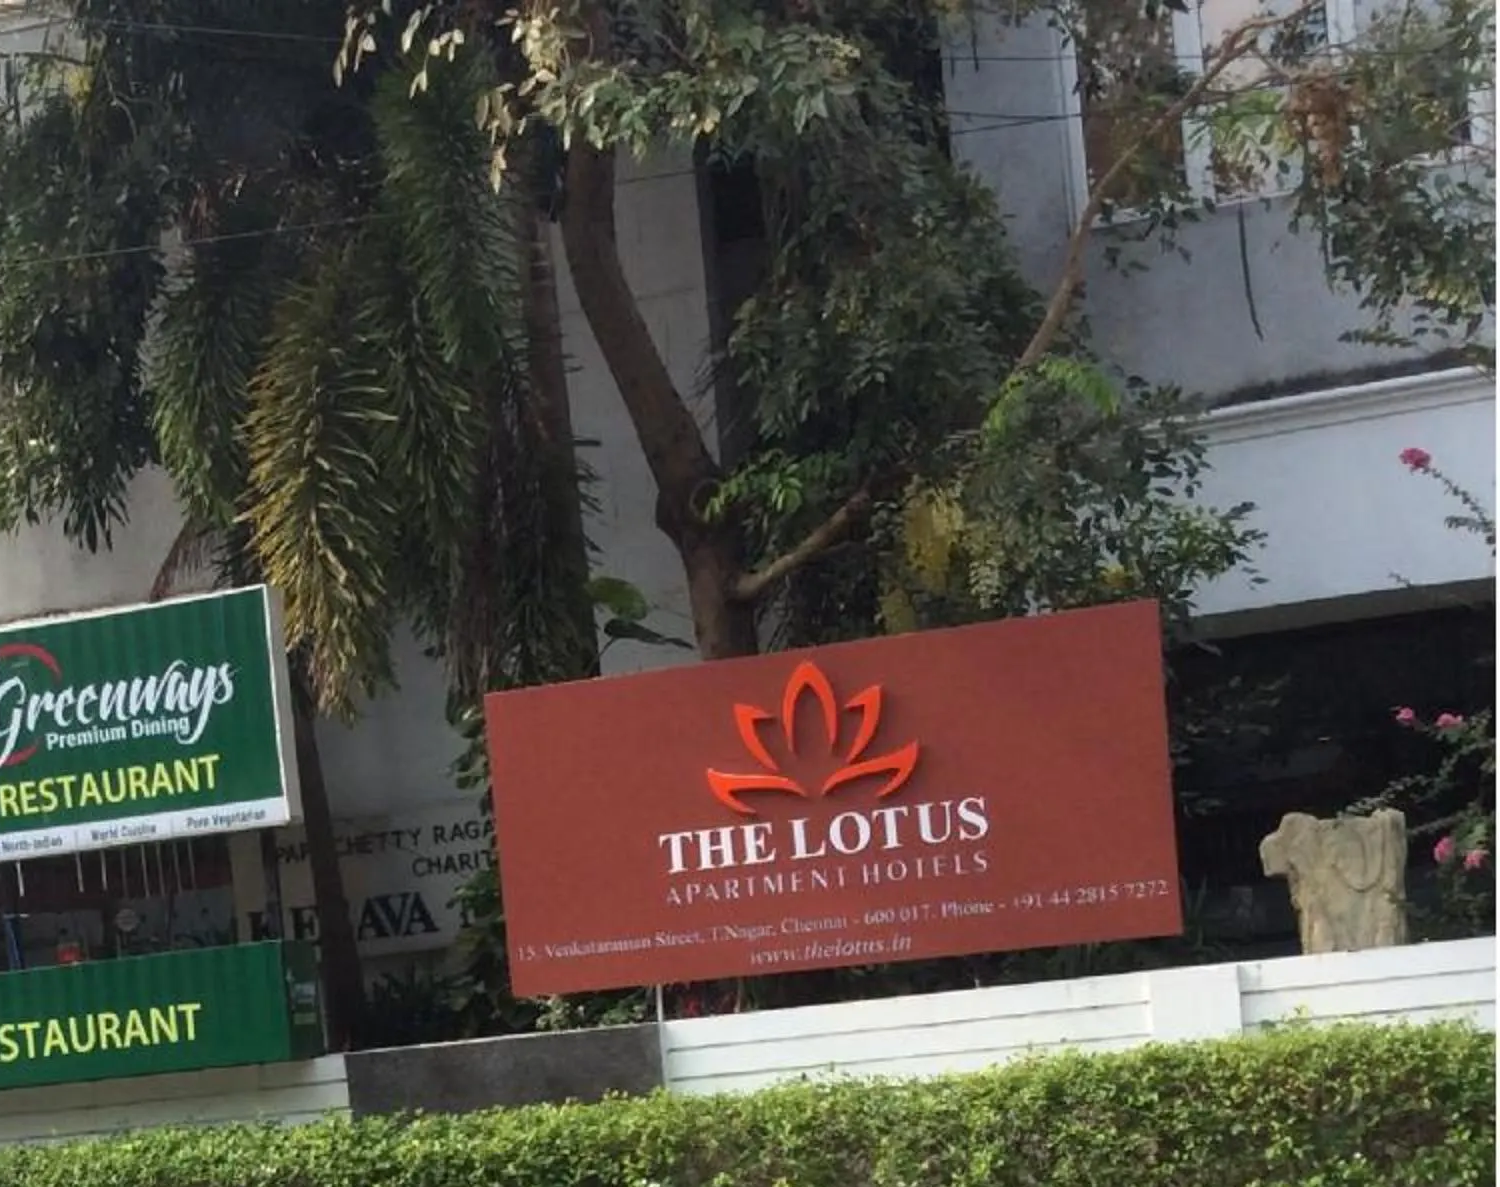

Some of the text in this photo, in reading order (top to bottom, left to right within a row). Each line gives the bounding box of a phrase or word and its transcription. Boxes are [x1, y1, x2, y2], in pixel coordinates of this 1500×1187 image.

[46, 716, 191, 751] Premium Dining
[659, 796, 990, 874] THE LOTUS
[666, 849, 989, 907] APARTMENT HOTELS
[781, 917, 847, 934] Chennai
[864, 908, 895, 925] 600
[941, 899, 993, 919] Phone
[1050, 890, 1070, 906] 44
[1077, 883, 1117, 903] 2815
[1123, 879, 1169, 898] 7272
[750, 932, 913, 965] www.thelotus.in
